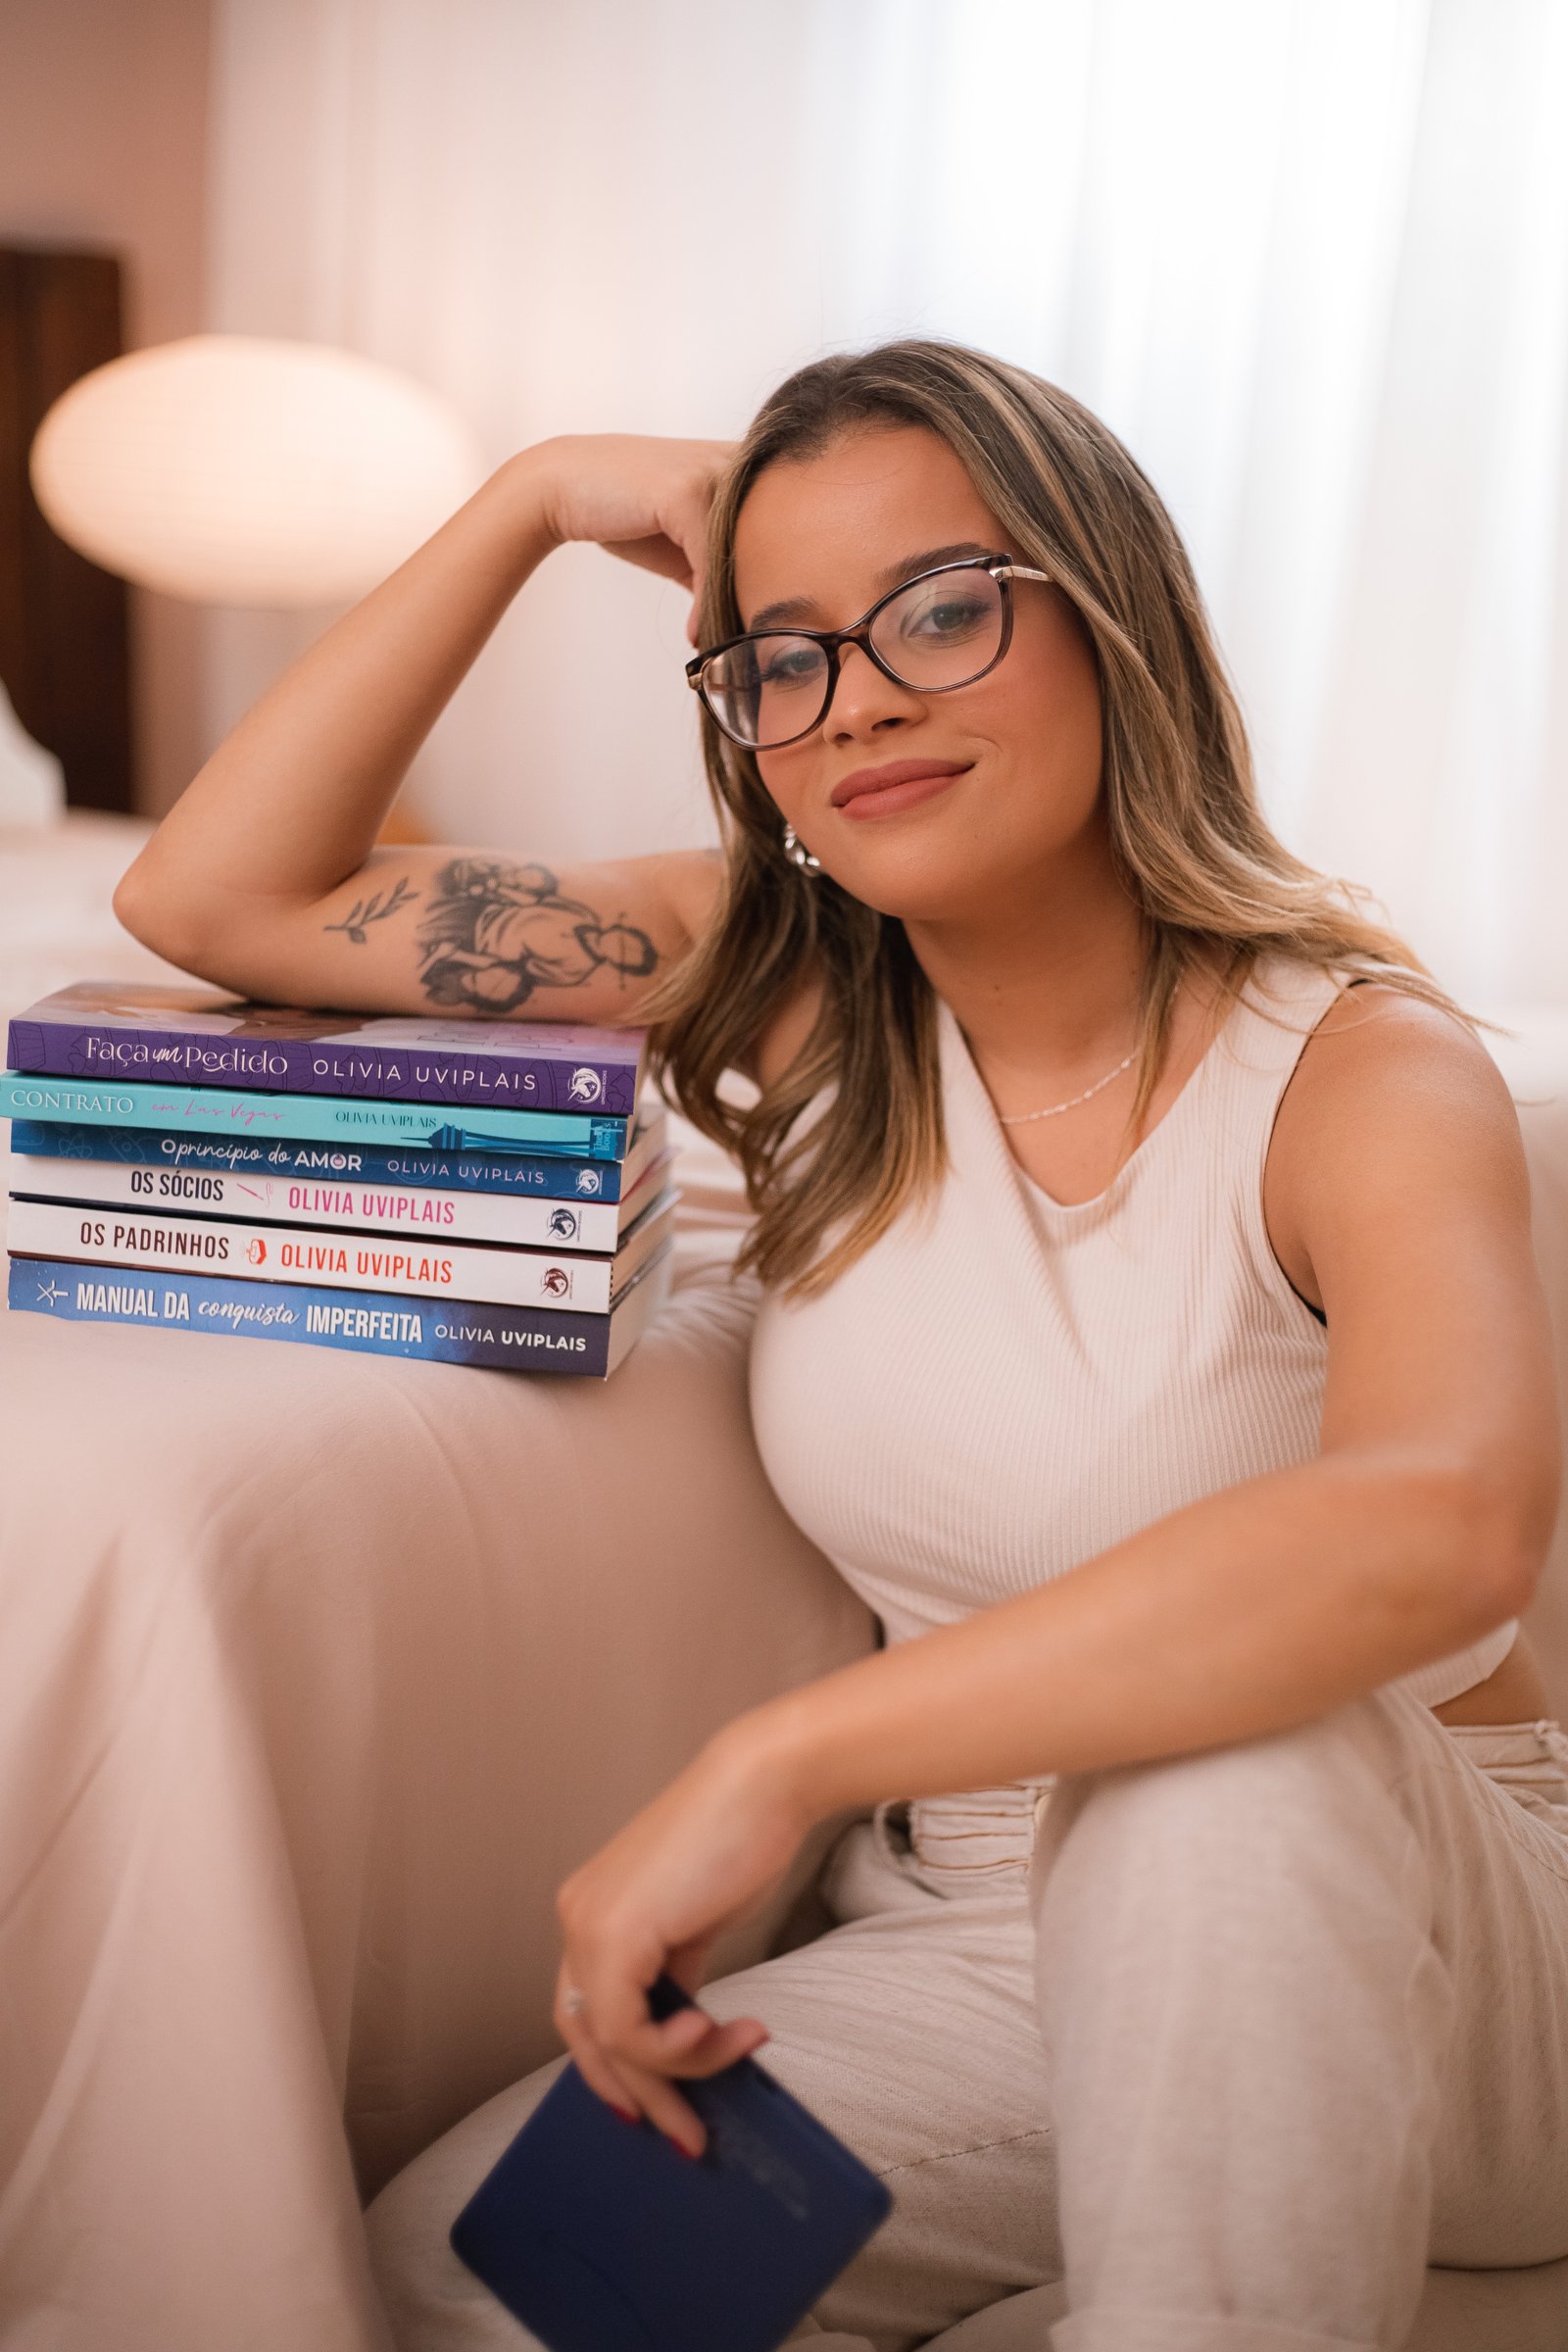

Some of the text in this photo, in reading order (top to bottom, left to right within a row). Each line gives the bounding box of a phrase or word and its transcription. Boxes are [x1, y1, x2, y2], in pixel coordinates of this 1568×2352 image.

[86, 1037, 288, 1075] Faça um Pedido
[314, 1059, 536, 1091] OLIVIA UVIPLAIS
[11, 1090, 133, 1114] CONTRATO
[184, 1099, 224, 1115] Las
[230, 1102, 284, 1126] Vegas
[335, 1111, 436, 1128] OLIVIA UVIPLAIS
[162, 1139, 362, 1172] O princípio do AMOR
[387, 1159, 545, 1185] OLIVIA UVIPLAIS
[130, 1170, 223, 1200] OS SÓCIOS
[288, 1187, 455, 1224] OLIVIA UVIPLAIS
[80, 1222, 229, 1259] OS PADRINHOS
[281, 1244, 453, 1283] OLIVIA UVIPLAIS
[76, 1283, 422, 1343] MANUAL DA conquista IMPERFEITA
[434, 1324, 586, 1351] OLIVIA UVIPLAIS
